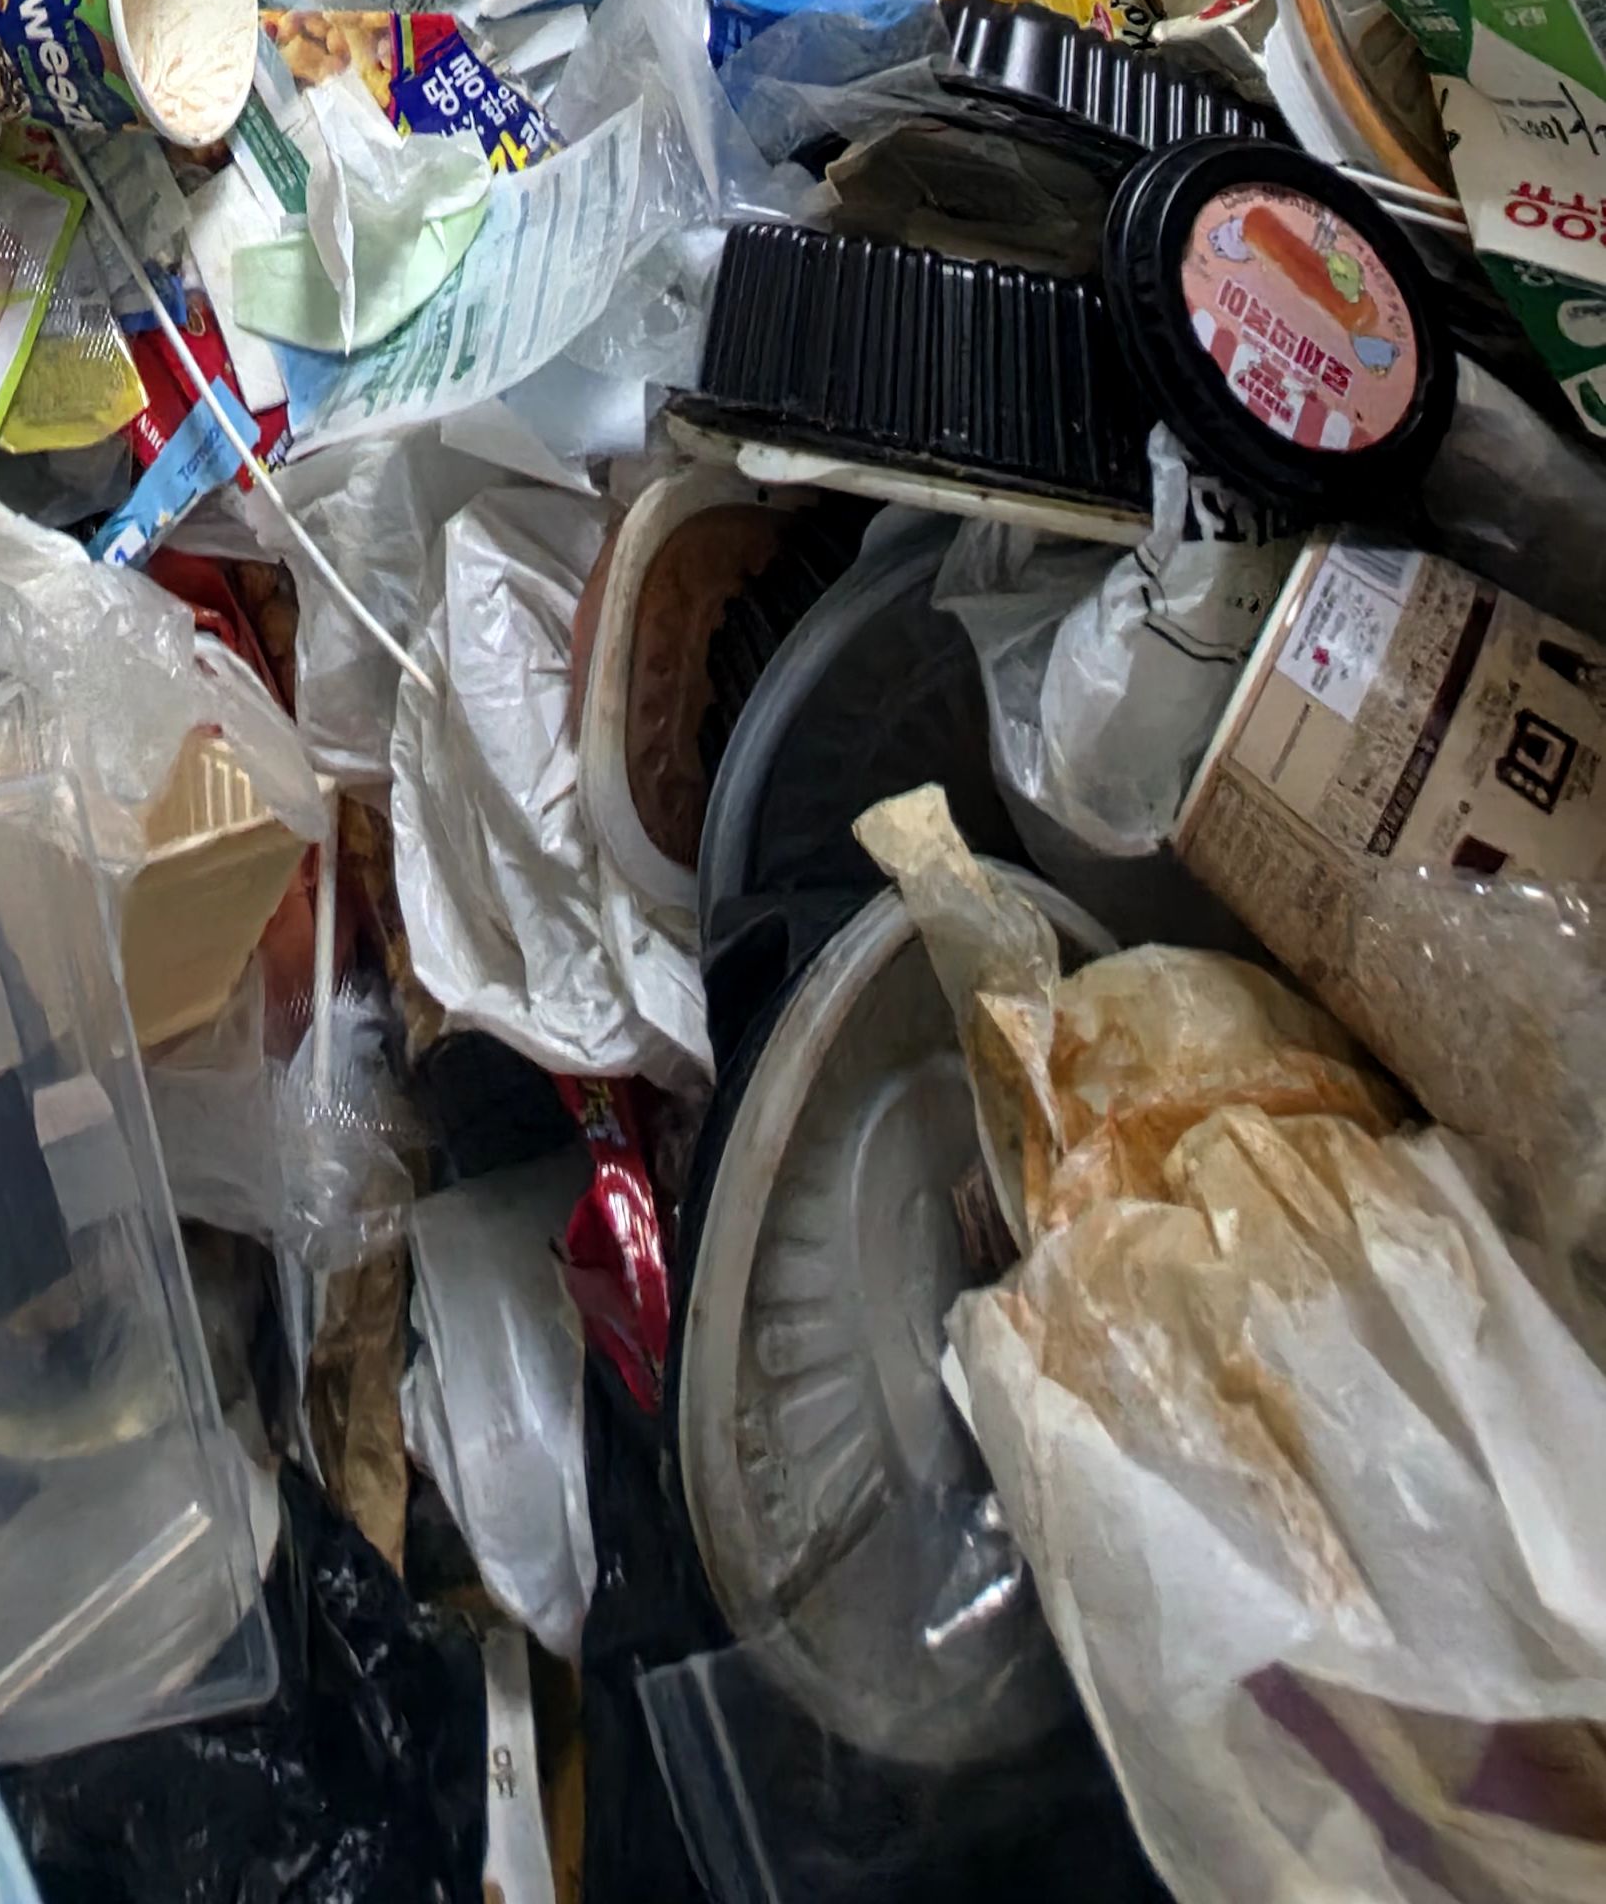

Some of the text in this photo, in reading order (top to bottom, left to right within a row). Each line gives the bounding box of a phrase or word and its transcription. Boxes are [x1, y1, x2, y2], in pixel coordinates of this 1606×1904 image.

[425, 53, 483, 117] 땅콩
[482, 85, 518, 127] 함유
[1502, 180, 1606, 245] 우유
